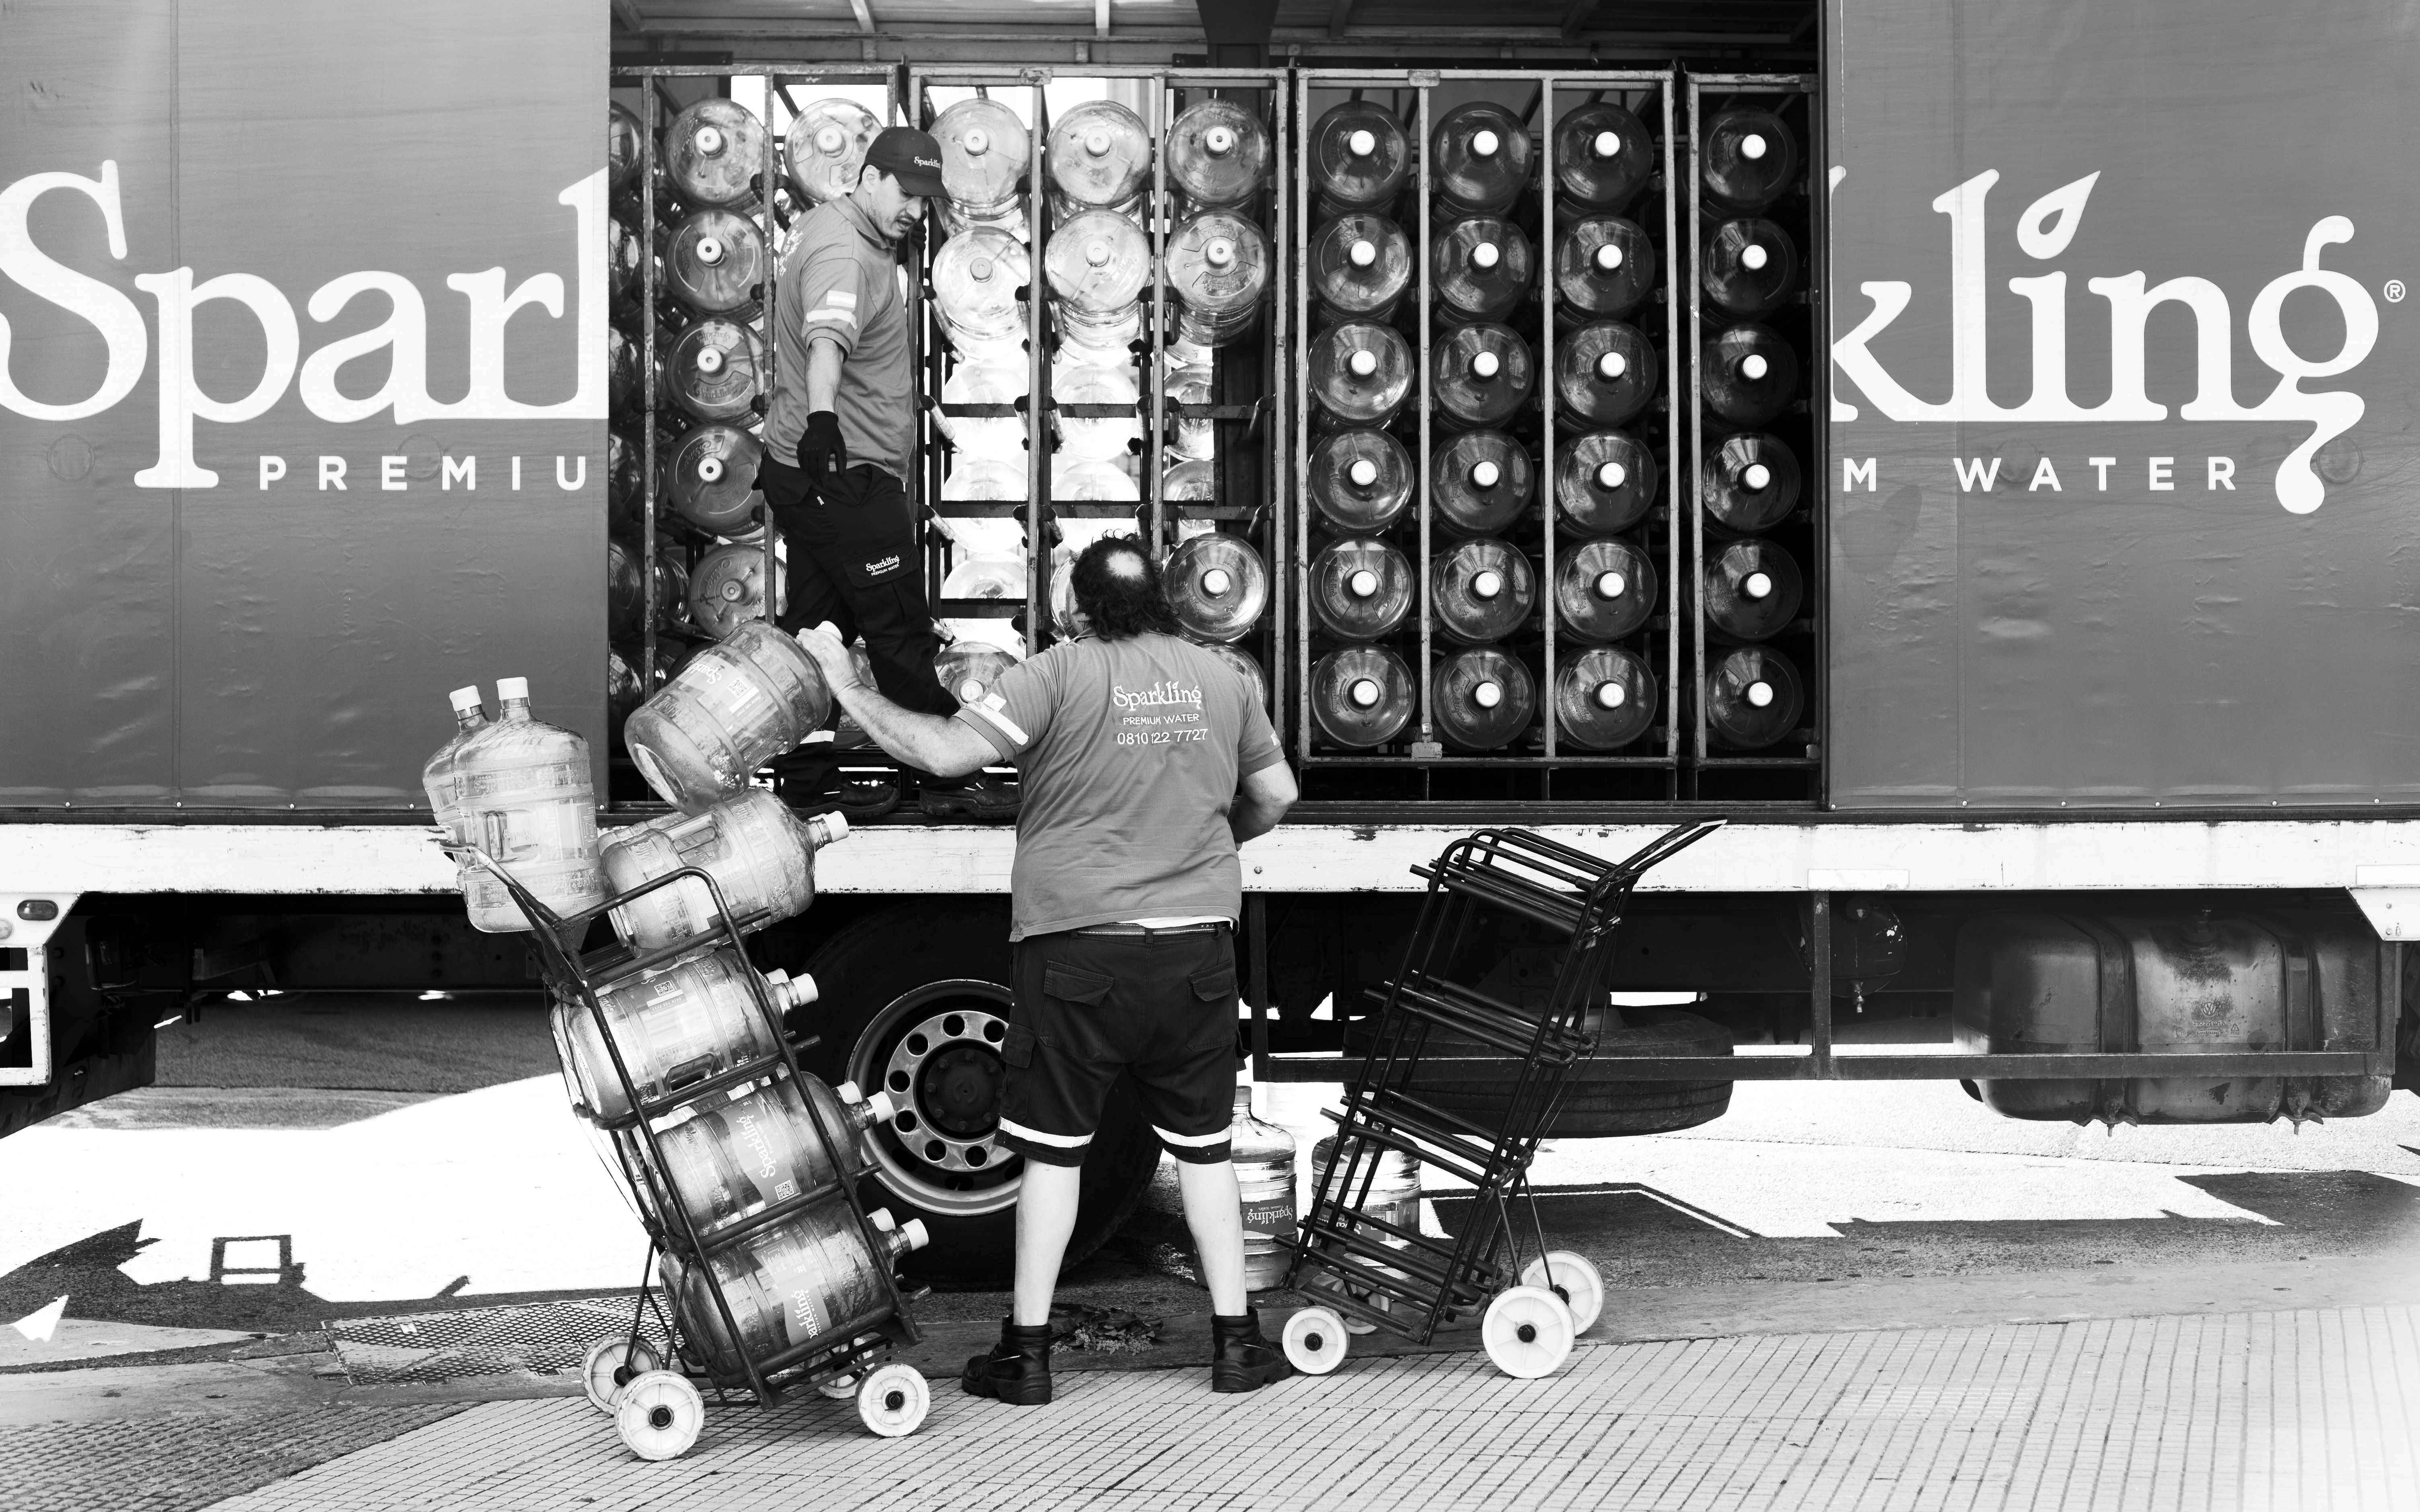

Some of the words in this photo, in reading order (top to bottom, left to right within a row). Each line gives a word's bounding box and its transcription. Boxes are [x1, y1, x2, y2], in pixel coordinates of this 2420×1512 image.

[259, 454, 588, 491] PREMIU
[1953, 456, 2236, 492] WATER
[866, 555, 900, 572] Sparkling
[871, 568, 888, 576] PREMIUM
[1113, 680, 1202, 711] Sparkling
[1123, 716, 1161, 725] PREMIUM
[1163, 713, 1200, 724] WATER
[1117, 732, 1148, 744] 0810
[1151, 732, 1171, 744] 122
[1174, 729, 1208, 742] 7727
[737, 1114, 777, 1178] Sparkling
[1247, 1205, 1293, 1225] Sparkling
[796, 1265, 803, 1274] 20
